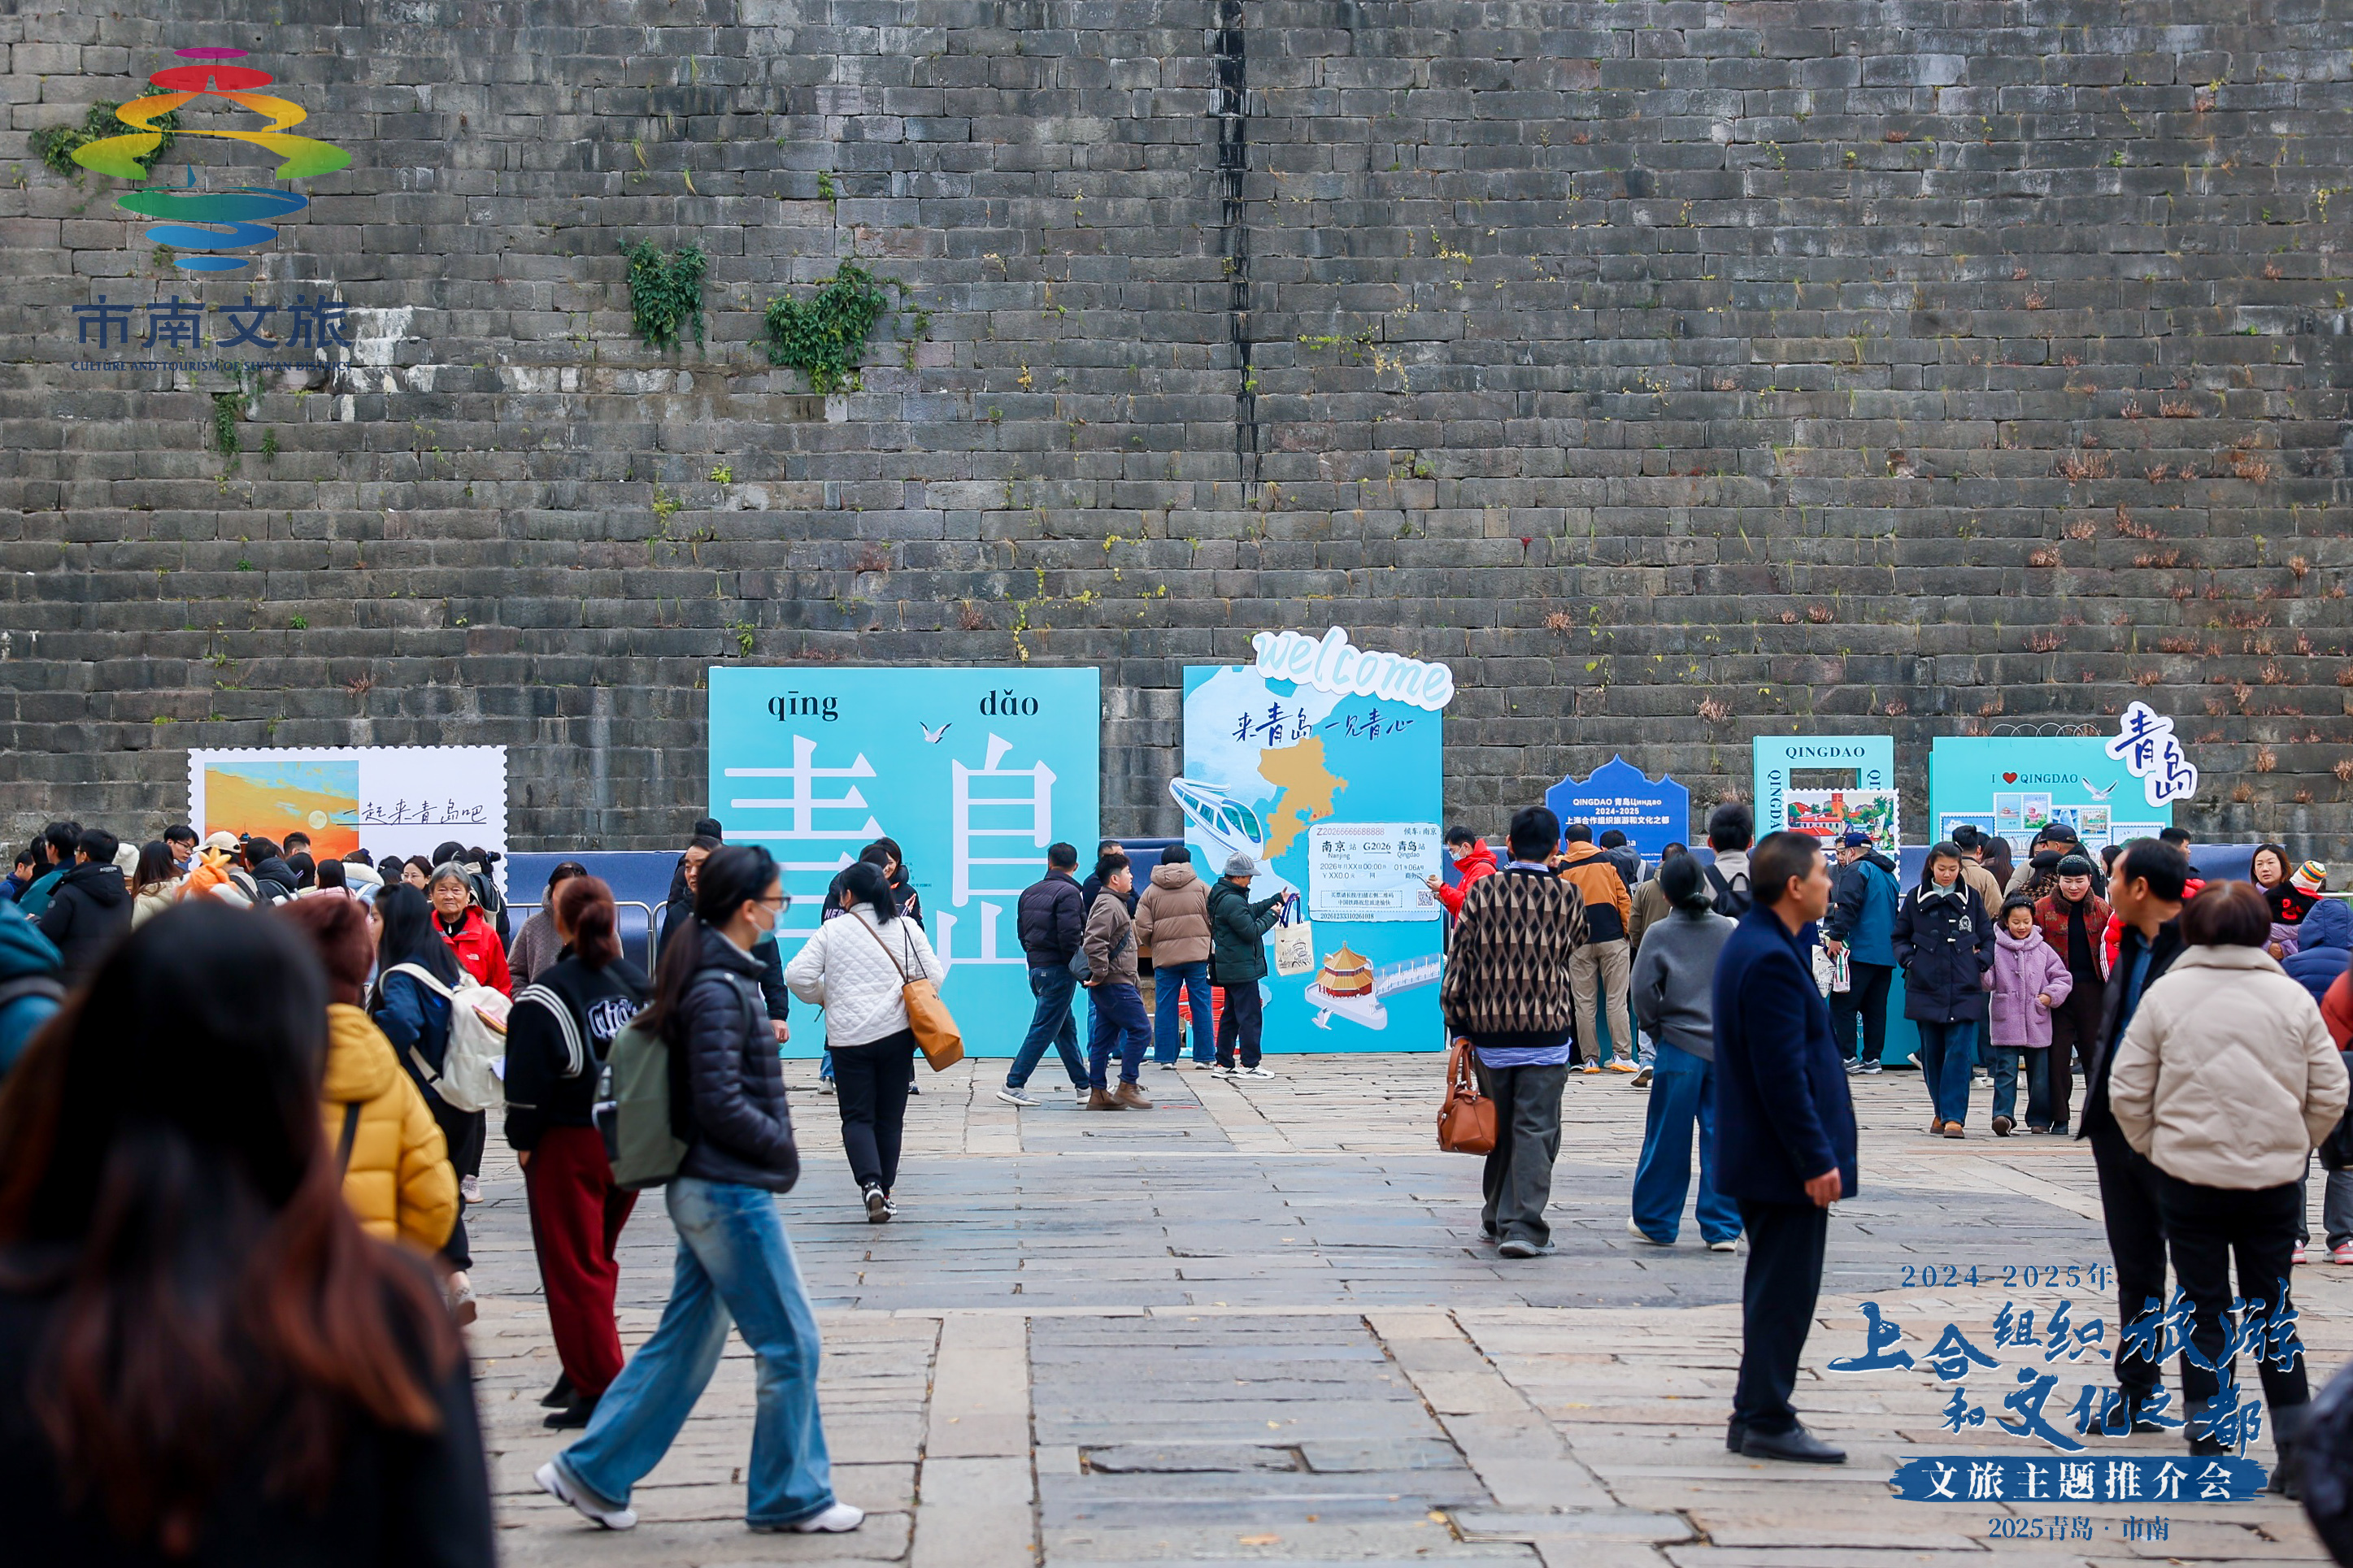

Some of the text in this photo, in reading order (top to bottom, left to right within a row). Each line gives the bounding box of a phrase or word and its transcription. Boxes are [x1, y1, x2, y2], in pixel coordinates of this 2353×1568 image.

[1255, 630, 1447, 702] welcome
[768, 688, 1039, 722] qīng dǎo
[1785, 746, 1865, 758] QINGDAO
[2114, 709, 2193, 799] 青岛
[1992, 773, 2078, 784] I QINGDAO
[1768, 769, 1782, 829] QINGDA
[343, 799, 487, 825] 一起来青岛吧
[1595, 807, 1640, 815] 2024-2025
[1565, 815, 1670, 825] 上海合作组织旅游和文化之都
[1363, 842, 1391, 851] G2026
[1328, 853, 1350, 861] Nanjing
